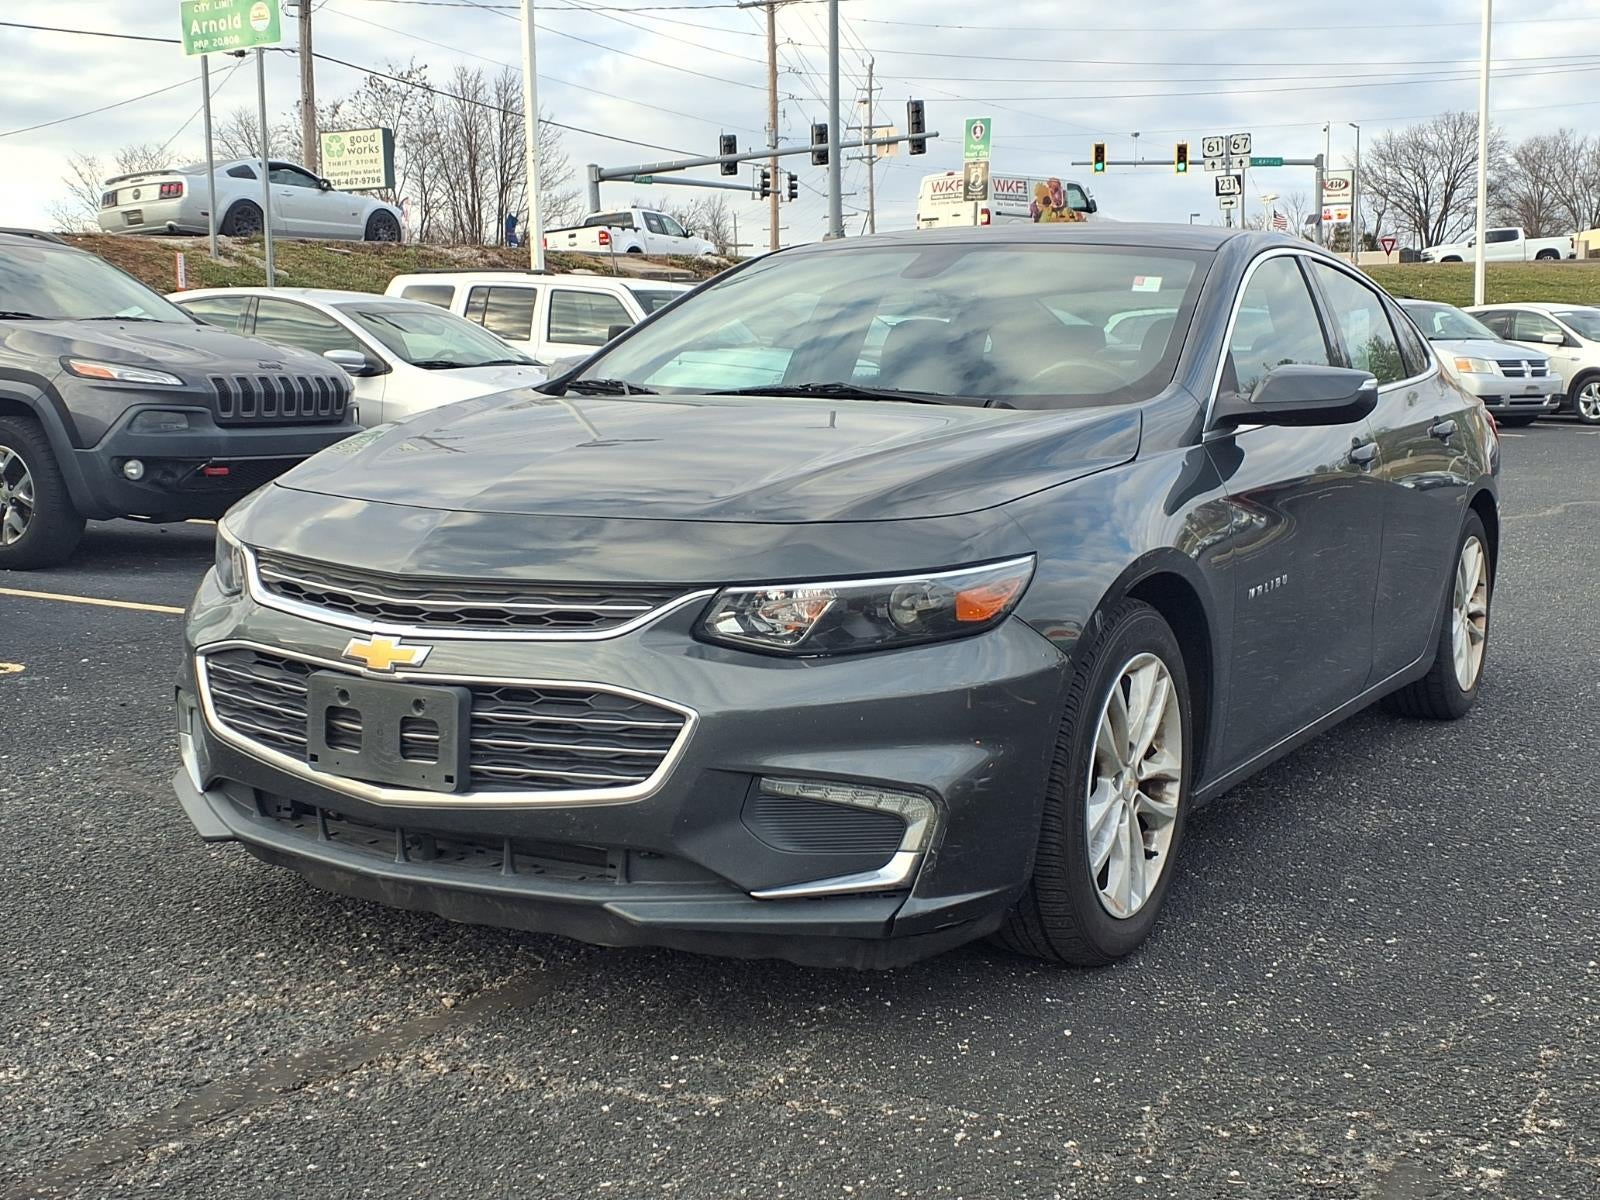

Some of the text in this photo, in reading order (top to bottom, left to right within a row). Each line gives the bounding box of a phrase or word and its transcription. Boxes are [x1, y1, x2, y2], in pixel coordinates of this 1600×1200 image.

[191, 13, 242, 36] Arnold
[349, 132, 376, 147] good
[1232, 137, 1249, 150] 67
[346, 143, 380, 155] works
[1207, 140, 1220, 153] 61
[327, 159, 353, 167] THRIFT
[332, 176, 381, 187] 36-467-9796
[931, 179, 963, 193] WKF
[992, 178, 1024, 193] WKF
[1220, 178, 1236, 191] 231
[1247, 573, 1288, 600] MALIBU
